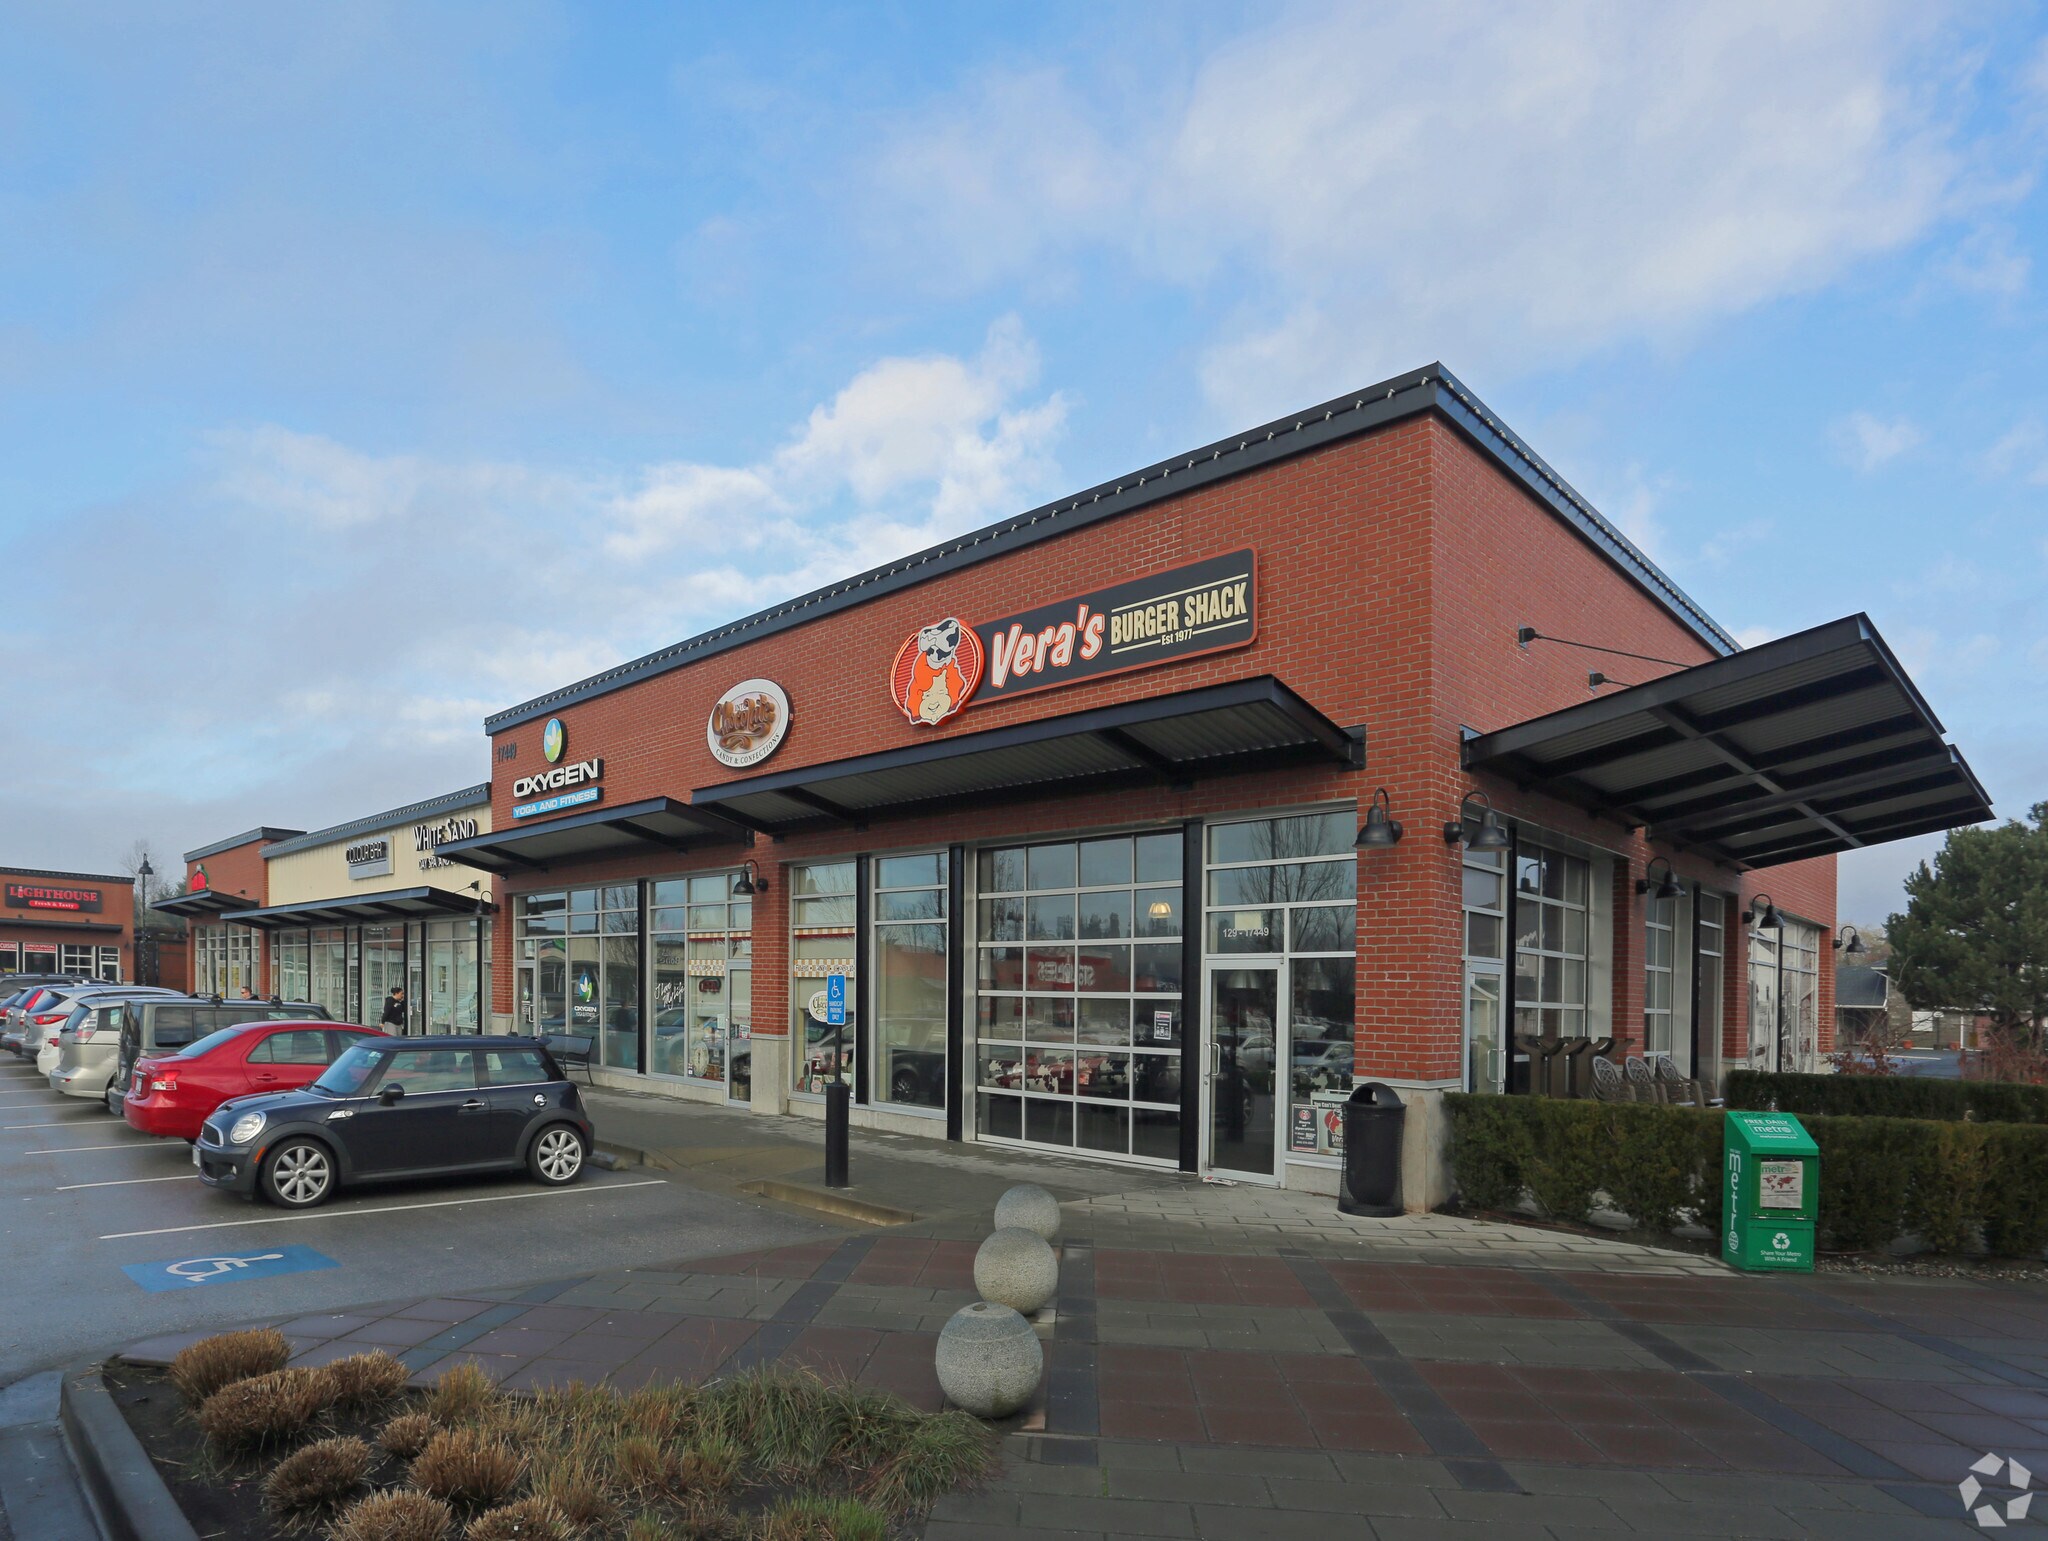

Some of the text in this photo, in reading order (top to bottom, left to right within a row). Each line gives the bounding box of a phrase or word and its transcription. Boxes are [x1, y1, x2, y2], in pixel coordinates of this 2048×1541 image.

[1111, 582, 1248, 645] BURGER SHACK
[991, 604, 1105, 688] Vera's
[1161, 629, 1193, 646] Est 1977
[497, 742, 516, 763] 17449
[715, 748, 733, 763] CANDY
[740, 732, 780, 764] CONFECTIONS
[513, 757, 599, 798] OXYGEN
[514, 790, 597, 816] YOGA AND FITNESS
[446, 818, 476, 841] SAND
[1222, 928, 1238, 938] 129
[1245, 927, 1269, 937] 17449
[1753, 1125, 1792, 1133] metro
[1728, 1152, 1741, 1250] metro
